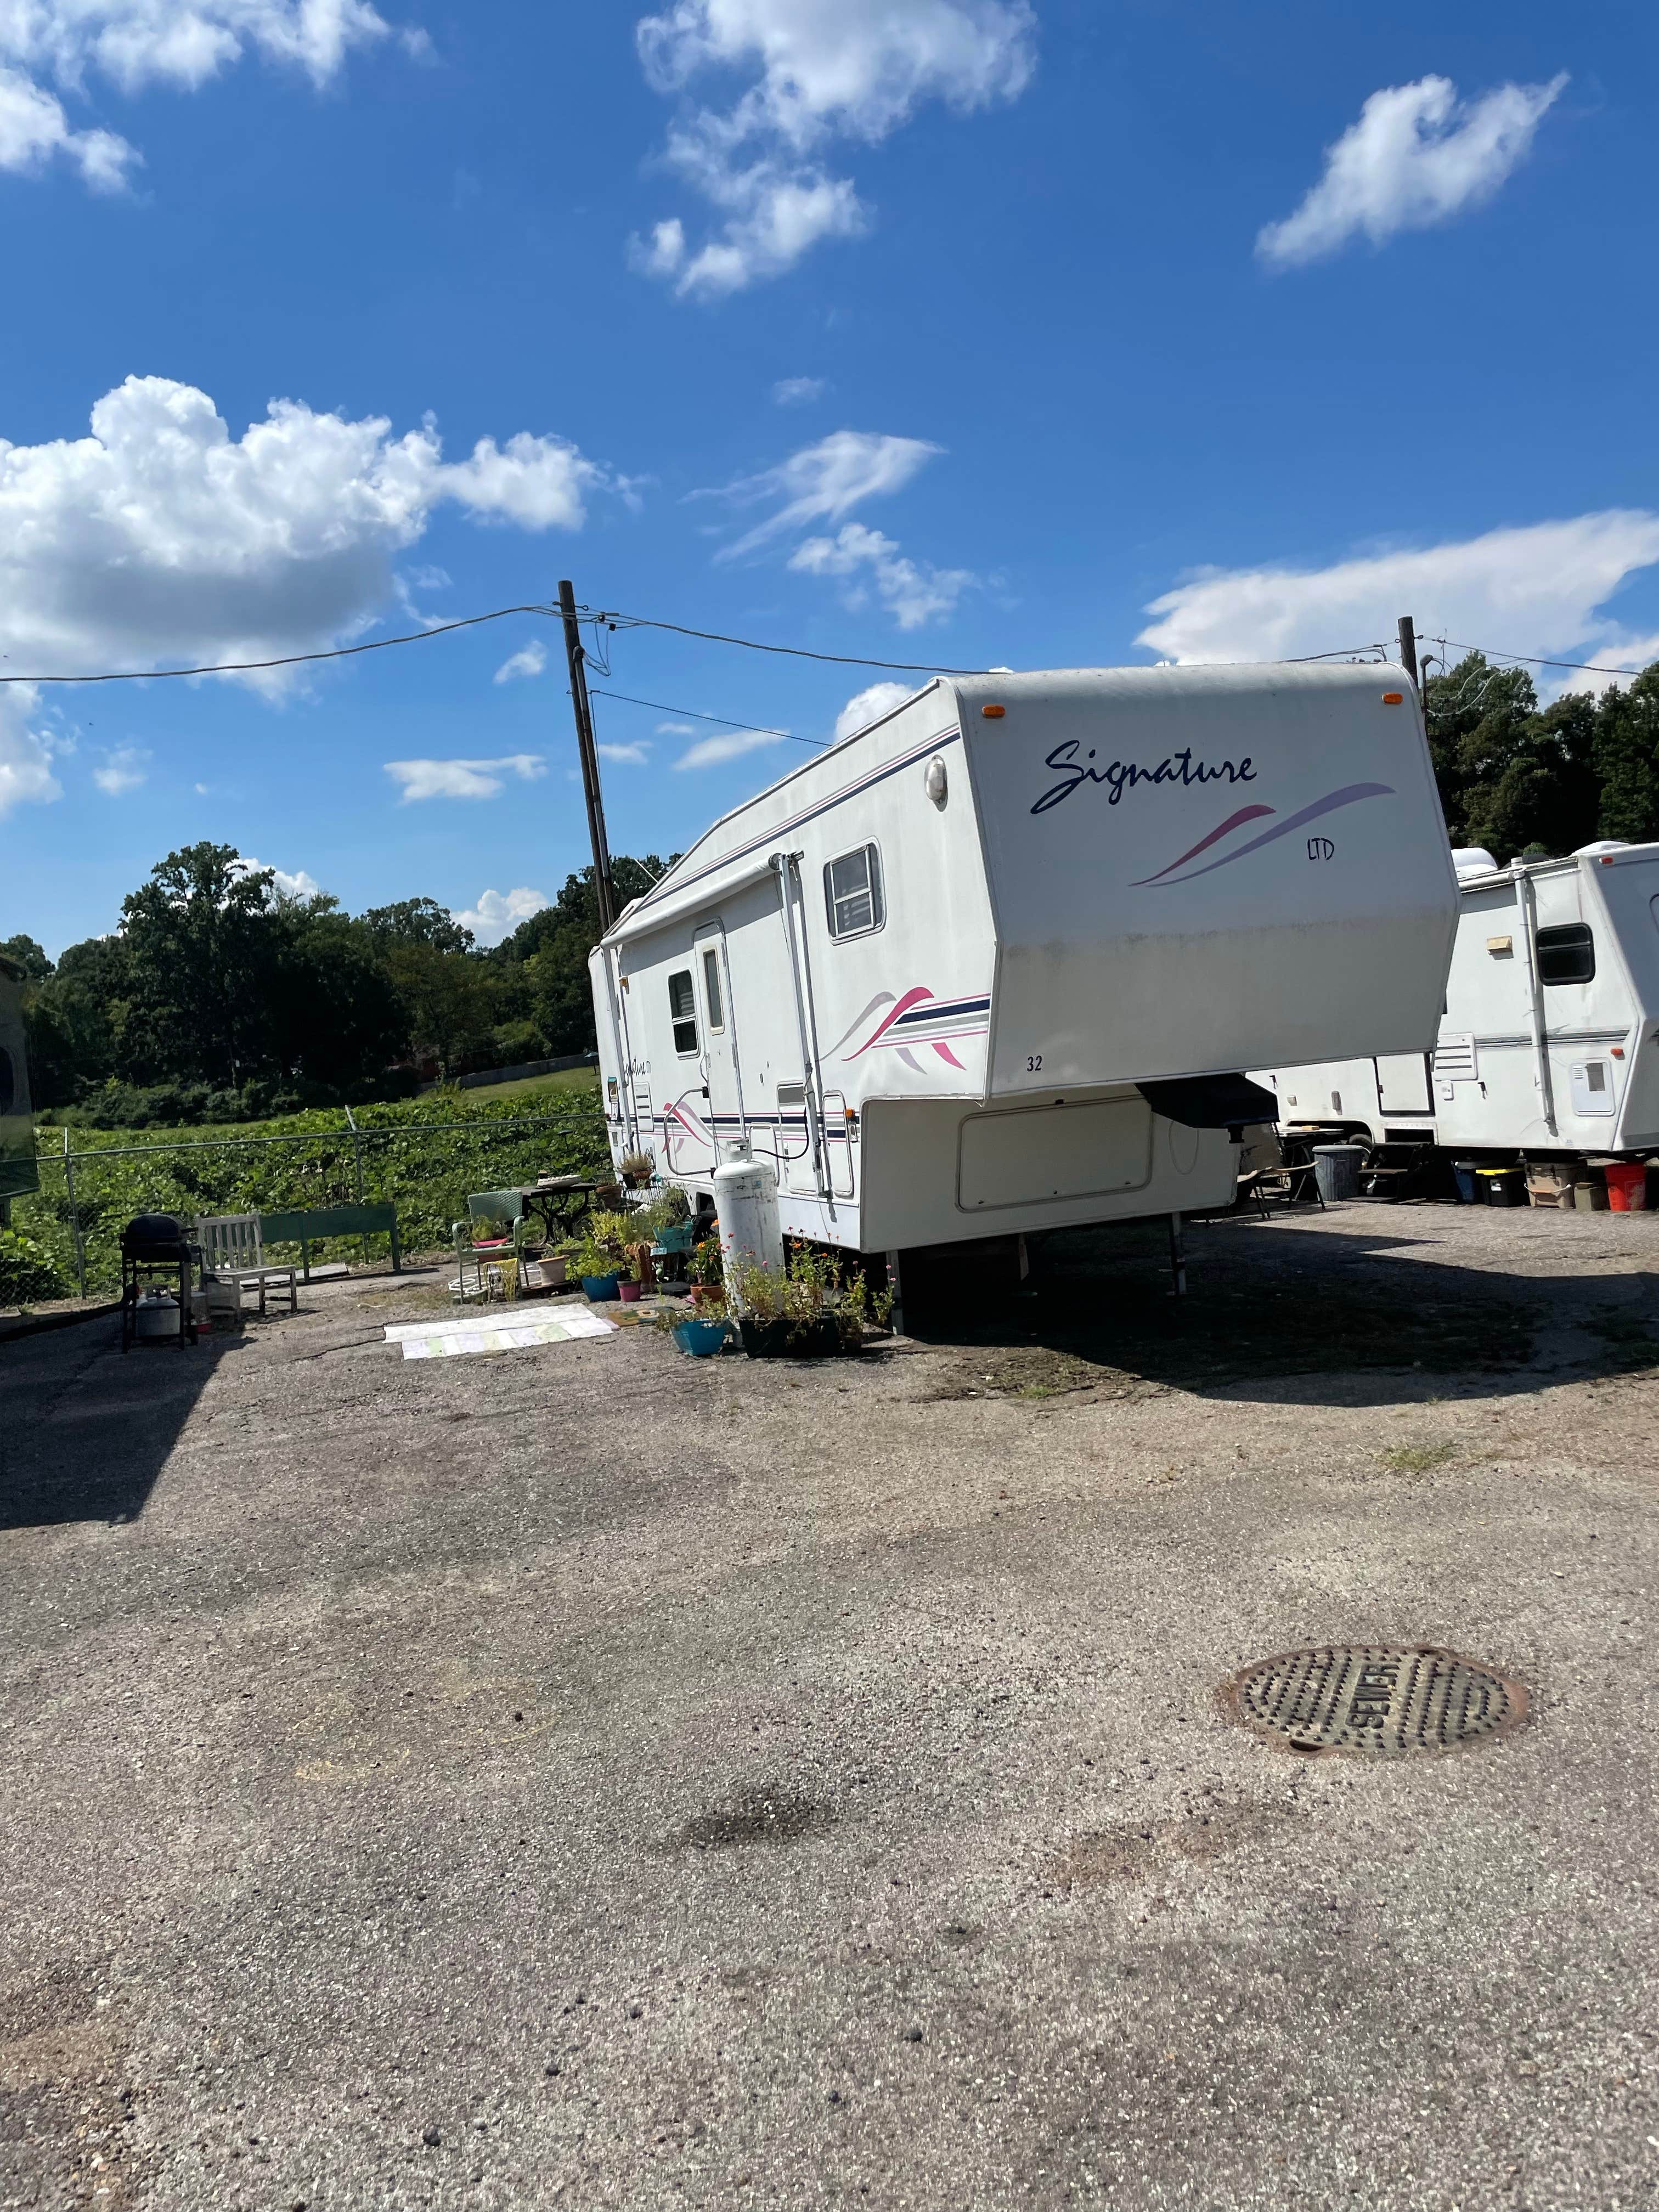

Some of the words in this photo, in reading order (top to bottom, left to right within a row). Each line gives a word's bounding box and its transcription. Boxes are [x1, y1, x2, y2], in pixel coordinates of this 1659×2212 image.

[1030, 740, 1257, 814] Signature
[1307, 838, 1334, 860] LTD
[1027, 1056, 1042, 1071] 32
[1345, 1664, 1400, 1729] SEWER
